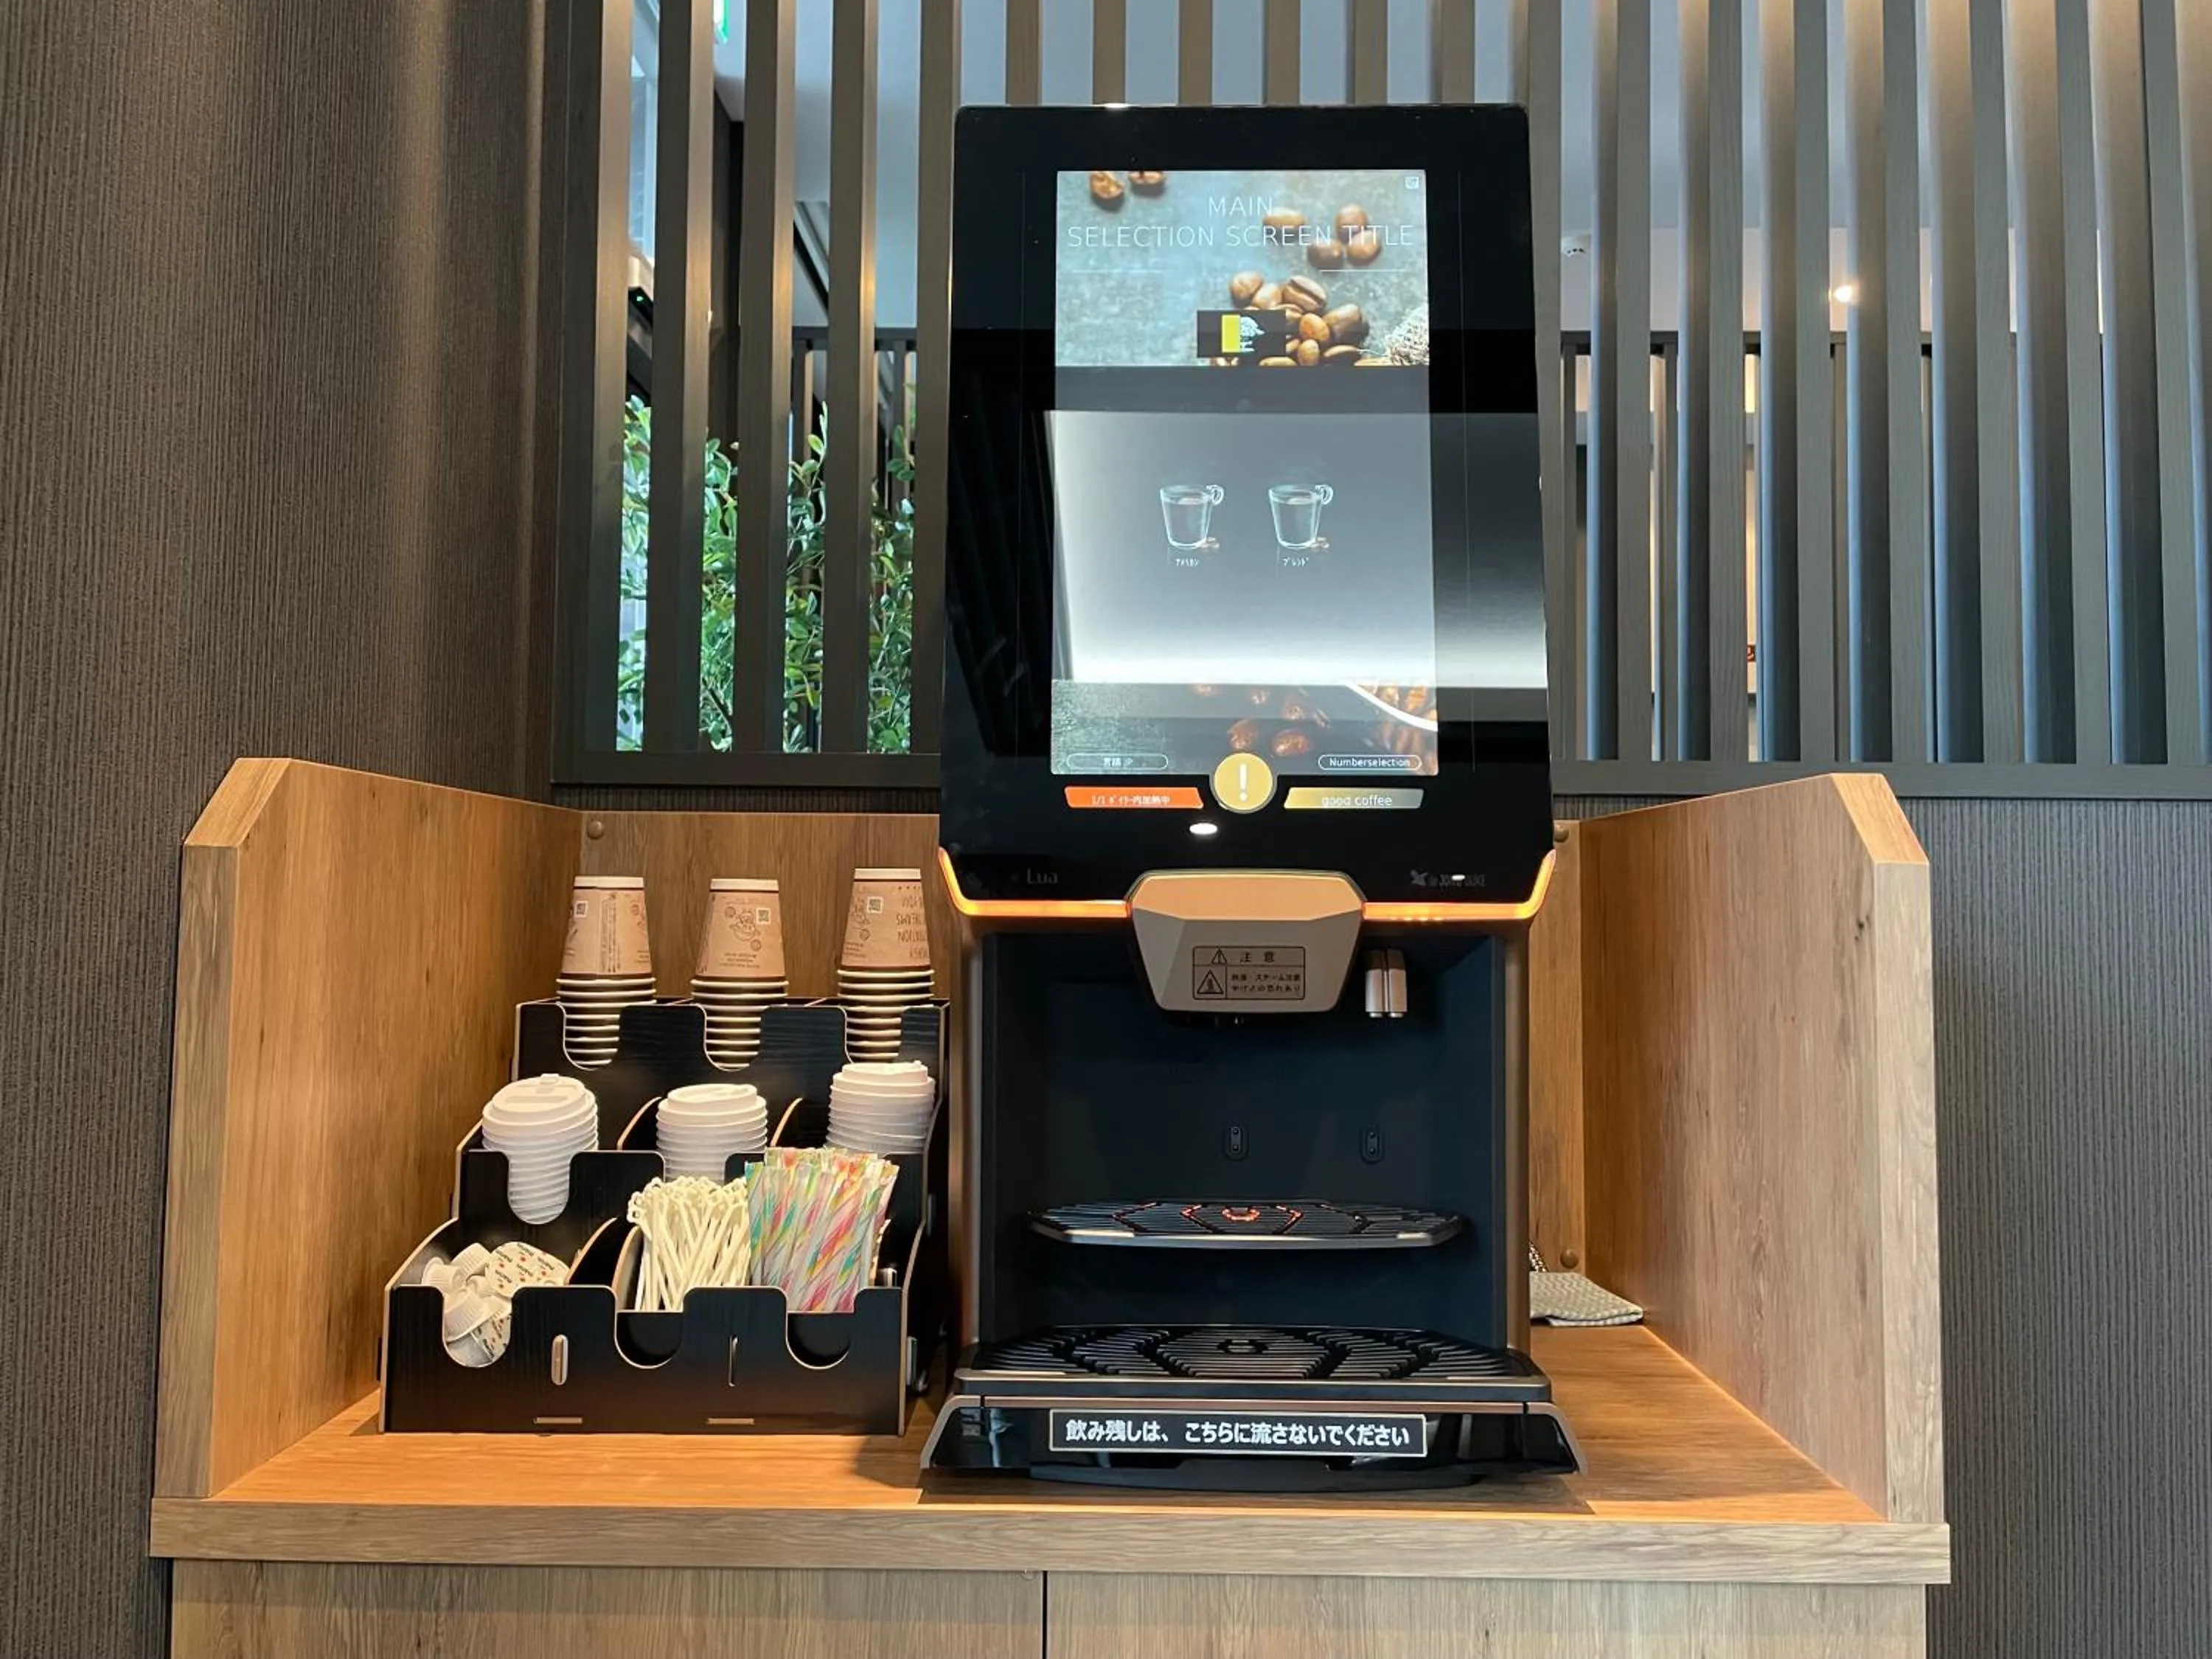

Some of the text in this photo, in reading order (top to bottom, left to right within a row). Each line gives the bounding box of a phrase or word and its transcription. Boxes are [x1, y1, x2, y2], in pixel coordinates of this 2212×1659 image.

[1208, 196, 1273, 216] MAIN
[1068, 225, 1414, 248] SELECTION SCREEN TITLE
[1329, 757, 1411, 768] Numberselection
[1321, 794, 1393, 808] good coffee
[1026, 867, 1058, 885] Lua
